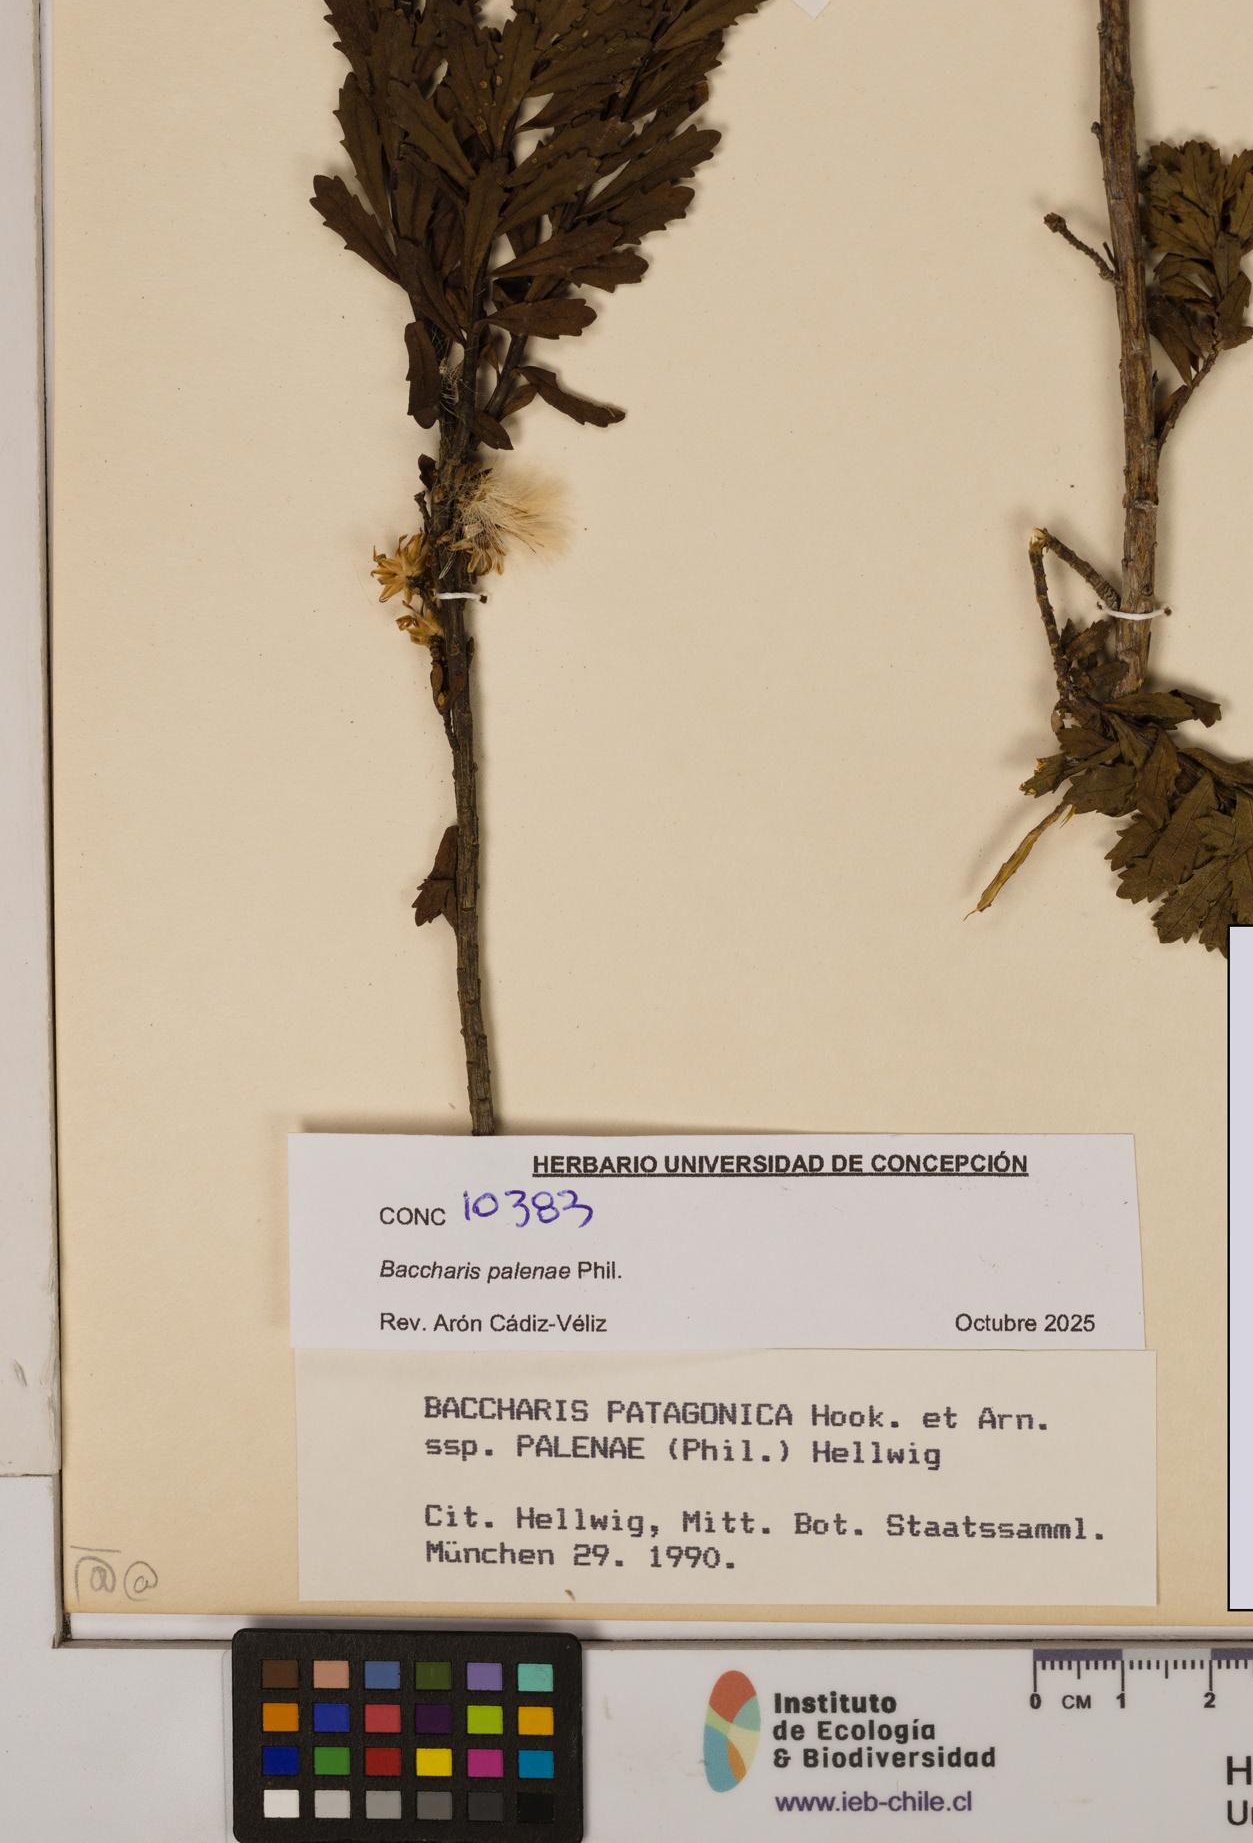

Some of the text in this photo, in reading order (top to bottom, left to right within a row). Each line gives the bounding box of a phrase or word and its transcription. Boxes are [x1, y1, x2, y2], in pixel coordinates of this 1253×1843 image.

[531, 1150, 1030, 1177] HERBARIO UNIVERSIDAD DE CONCEPCIÓN
[379, 1206, 446, 1226] CONC
[462, 1189, 594, 1228] 10383
[379, 1259, 622, 1284] Baccharis palenae Phil.
[380, 1312, 608, 1333] Rev. Arón Cádiz-Véliz
[955, 1312, 1096, 1333] Octubre 2025
[423, 1395, 1048, 1431] BACCHARIS PATAGONICA Hook. et Arn.
[424, 1434, 941, 1471] ssp. PALENAE (Phil.) Hellwig
[424, 1504, 1104, 1541] Cit. Hellwig, Mitt. Bot. Staatssamml.
[425, 1540, 735, 1570] München 29. 1990.
[774, 1690, 897, 1715] Instituto
[1029, 1692, 1042, 1710] 0
[1061, 1694, 1092, 1710] CM
[1116, 1692, 1126, 1709] 1
[1203, 1691, 1216, 1709] 2
[772, 1718, 936, 1745] de Ecología
[773, 1745, 996, 1769] & Biodiversidad
[774, 1790, 972, 1812] www.ieb-chile.cl
